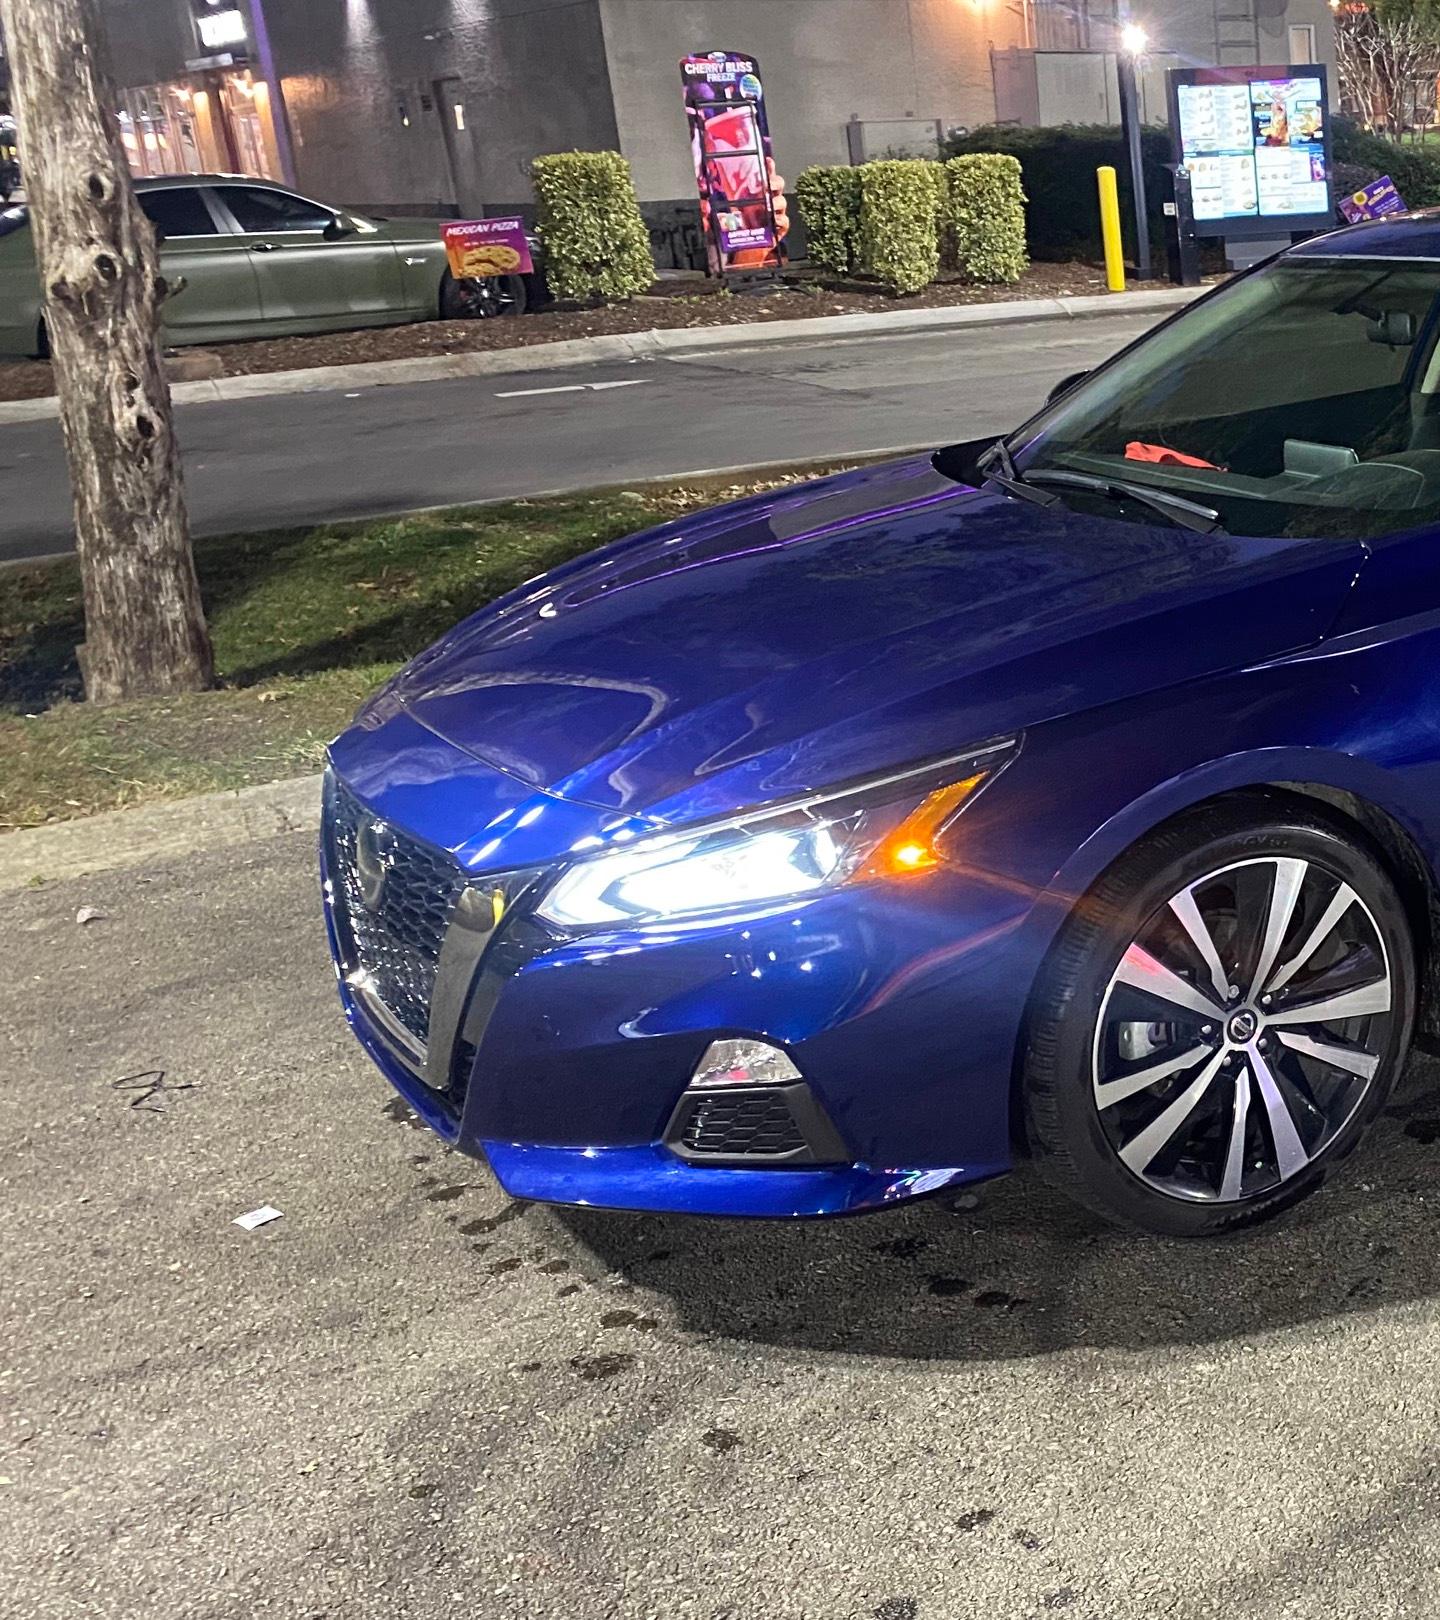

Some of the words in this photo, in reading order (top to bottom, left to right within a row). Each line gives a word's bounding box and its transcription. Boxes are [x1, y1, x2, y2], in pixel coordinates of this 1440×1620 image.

[684, 62, 725, 75] CHERRY
[725, 61, 753, 73] BLISS
[706, 72, 736, 82] FREEZE
[446, 223, 490, 237] MEXICAN
[491, 221, 519, 232] PIZZA
